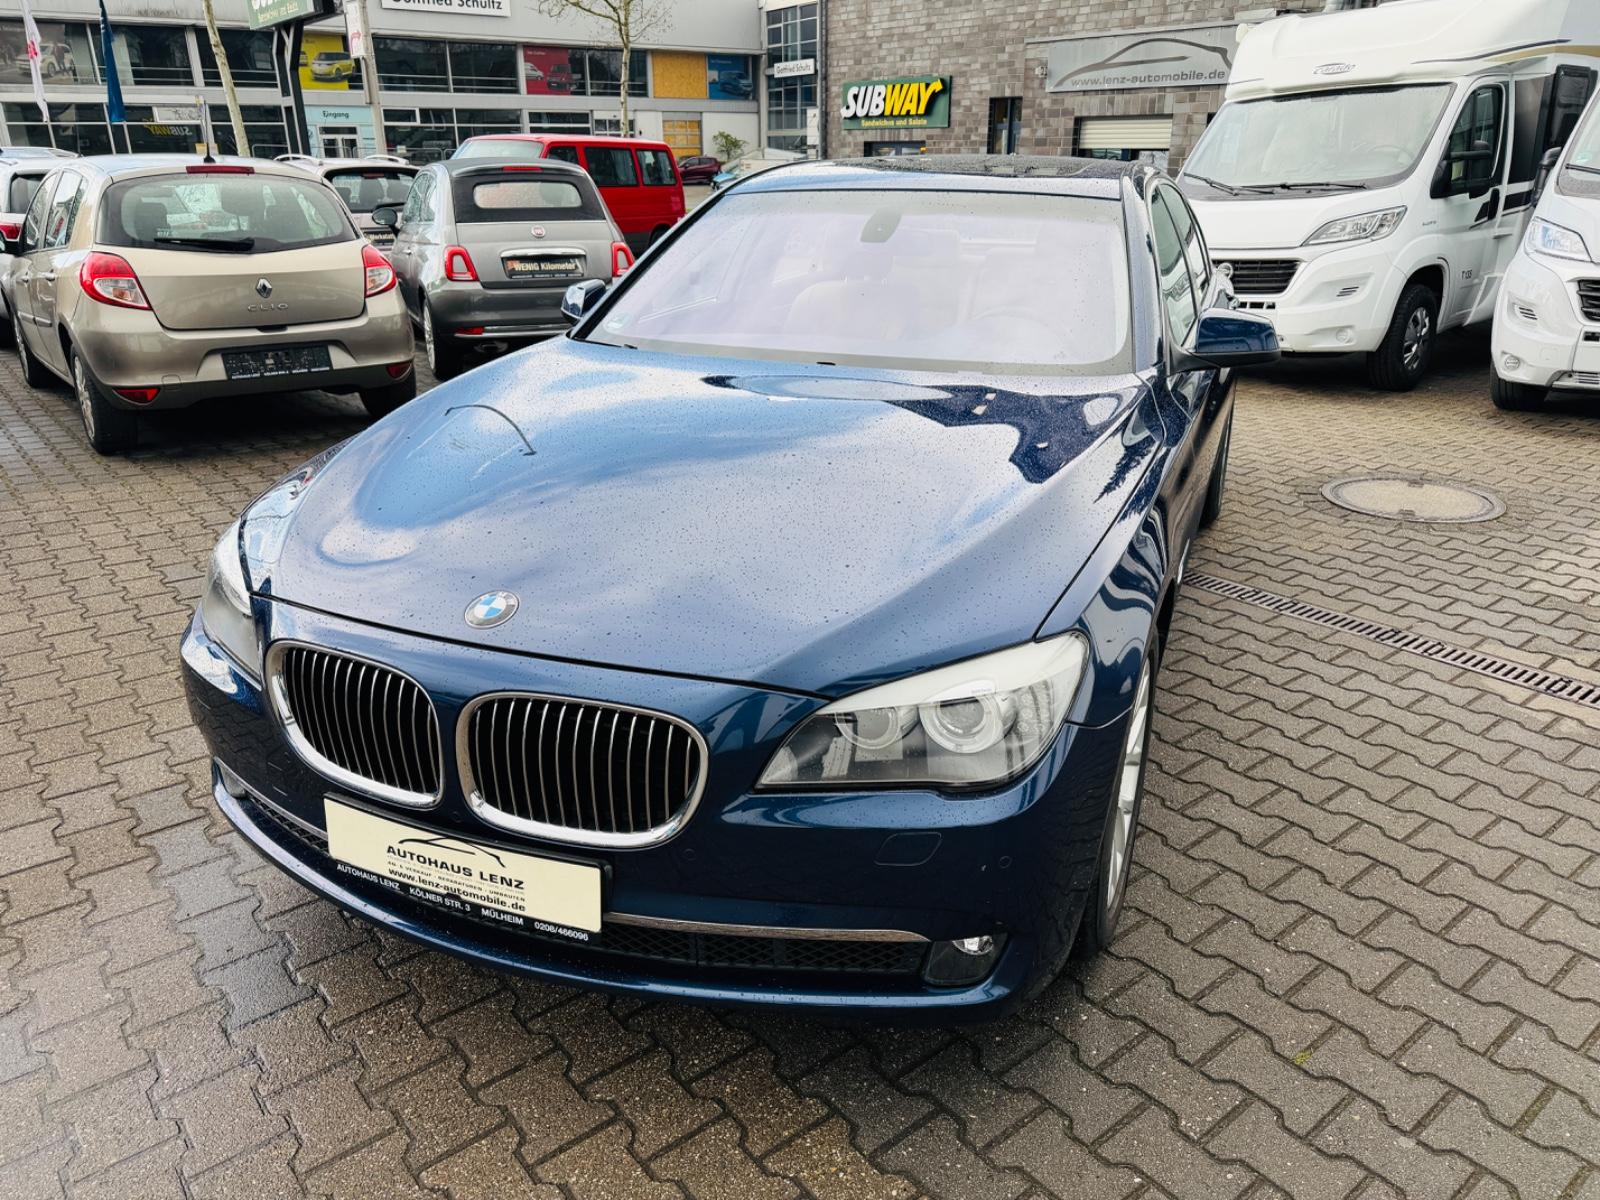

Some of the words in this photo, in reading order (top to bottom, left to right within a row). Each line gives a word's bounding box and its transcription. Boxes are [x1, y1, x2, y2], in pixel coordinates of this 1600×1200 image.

[1071, 69, 1226, 87] www.lenz-automobile.de
[322, 110, 350, 119] Eingang
[840, 79, 943, 119] SUBWAY
[247, 303, 289, 312] CLIO
[386, 845, 473, 877] AUTOHAUS
[479, 871, 525, 890] LENZ
[336, 863, 379, 884] AUTOHAUS
[379, 877, 401, 890] LENZ
[409, 886, 443, 905] KÖLNER
[444, 898, 464, 911] STR.
[464, 903, 472, 912] 3
[481, 907, 525, 926] MÜLHEIM
[388, 868, 526, 912] www.lenz-automobile.de
